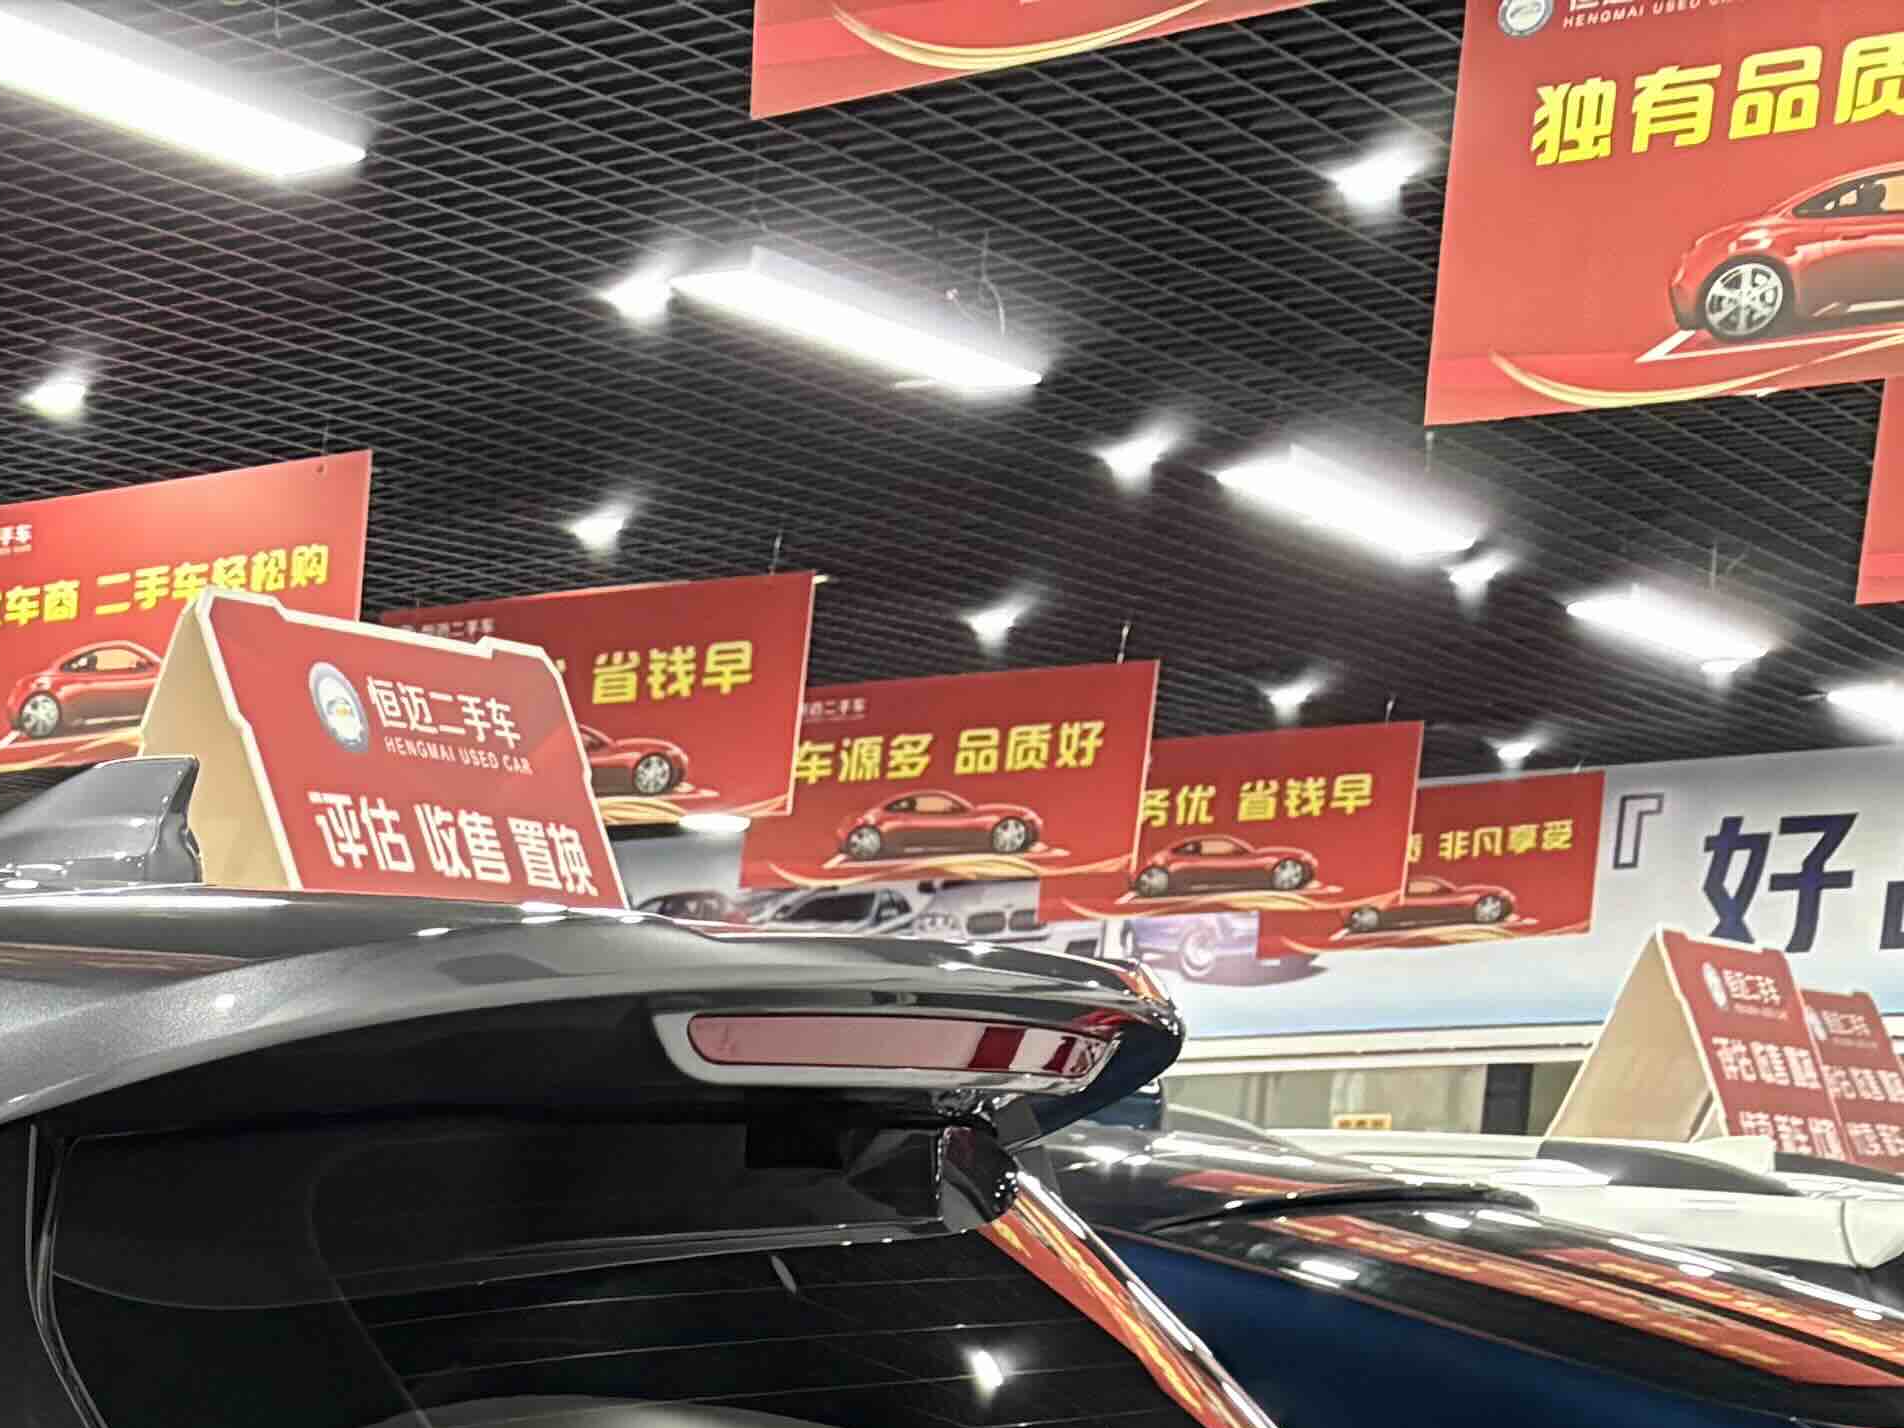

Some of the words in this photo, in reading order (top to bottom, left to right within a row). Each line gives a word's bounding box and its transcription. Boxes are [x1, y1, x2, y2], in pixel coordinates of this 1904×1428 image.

[96, 543, 329, 616] 二手车轻松购
[592, 640, 753, 704] 省钱早
[366, 676, 520, 749] 恒迈二手车
[384, 736, 455, 762] HENGMAI
[462, 749, 499, 769] USED
[503, 754, 533, 776] CAR
[794, 733, 933, 784] 车源多
[954, 720, 1105, 775] 品质好
[1237, 773, 1373, 822] 省钱早
[308, 792, 415, 873] 评估
[414, 803, 512, 884] 收售
[507, 817, 599, 896] 置换
